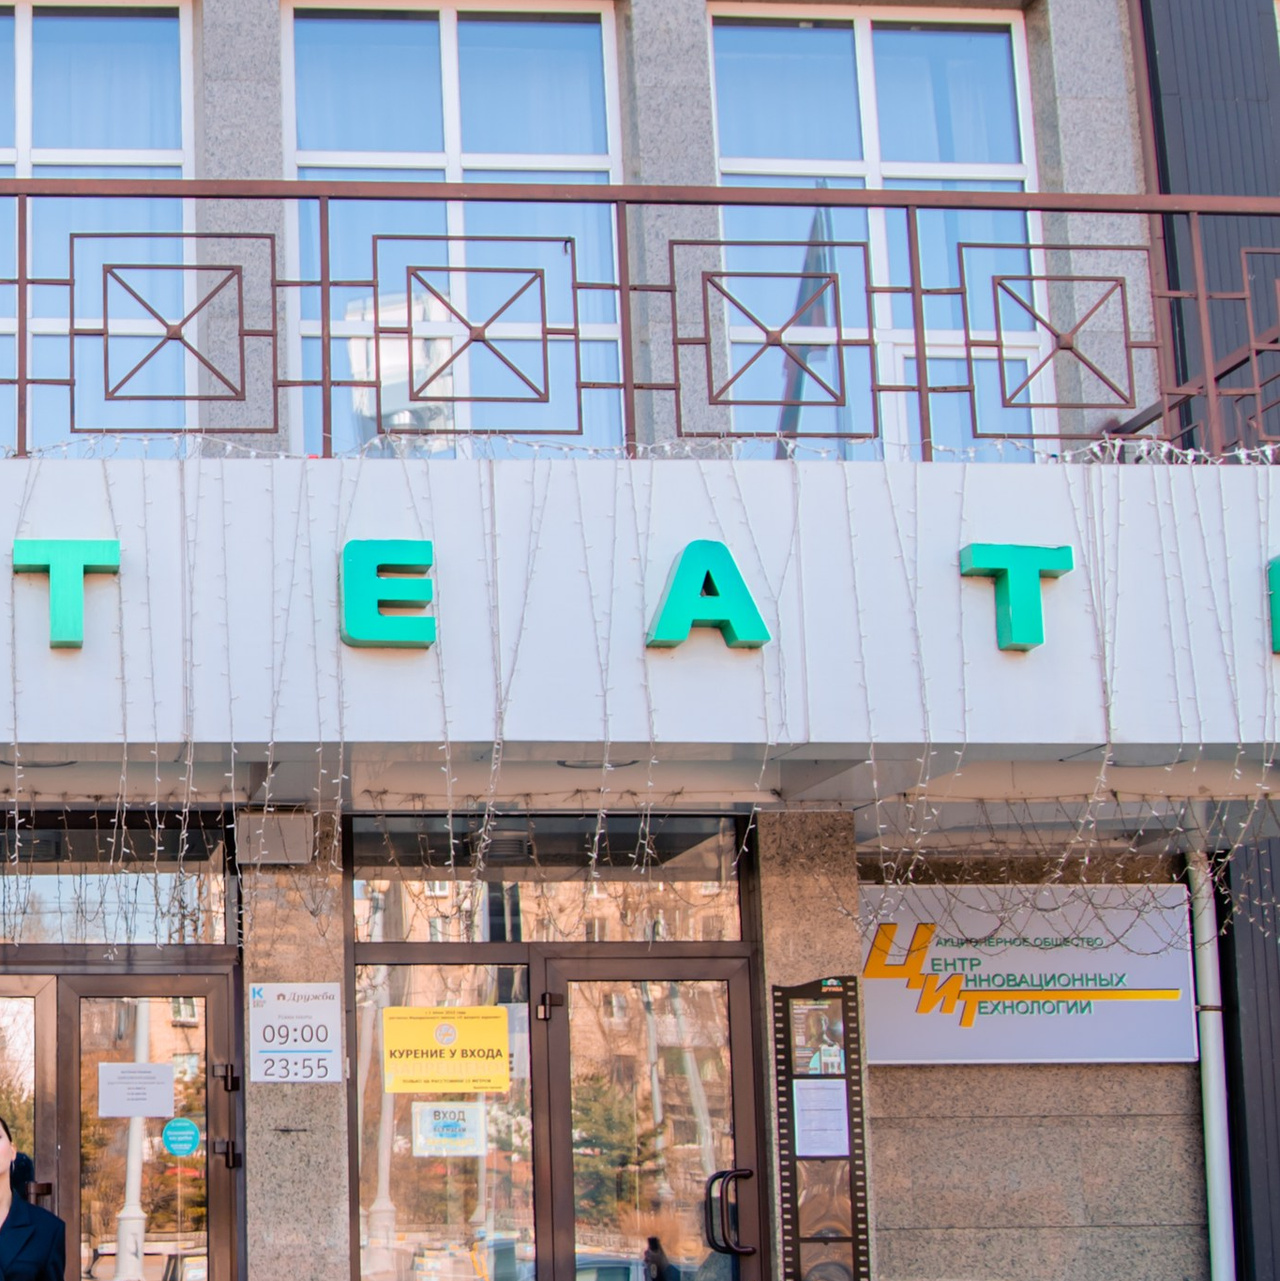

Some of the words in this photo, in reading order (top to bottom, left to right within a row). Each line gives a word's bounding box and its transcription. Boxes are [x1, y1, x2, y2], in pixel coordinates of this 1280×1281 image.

[934, 936, 1030, 949] АКЦИОНЕРНОЕ
[1032, 936, 1105, 948] ОБЩЕСТВО
[286, 991, 336, 1003] Дружба
[262, 1024, 329, 1046] 09:00
[389, 1048, 446, 1059] КУРЕНИЕ
[449, 1048, 458, 1059] У
[460, 1048, 504, 1060] ВХОДА
[263, 1058, 329, 1079] 23:55
[433, 1110, 466, 1122] ВХОД
